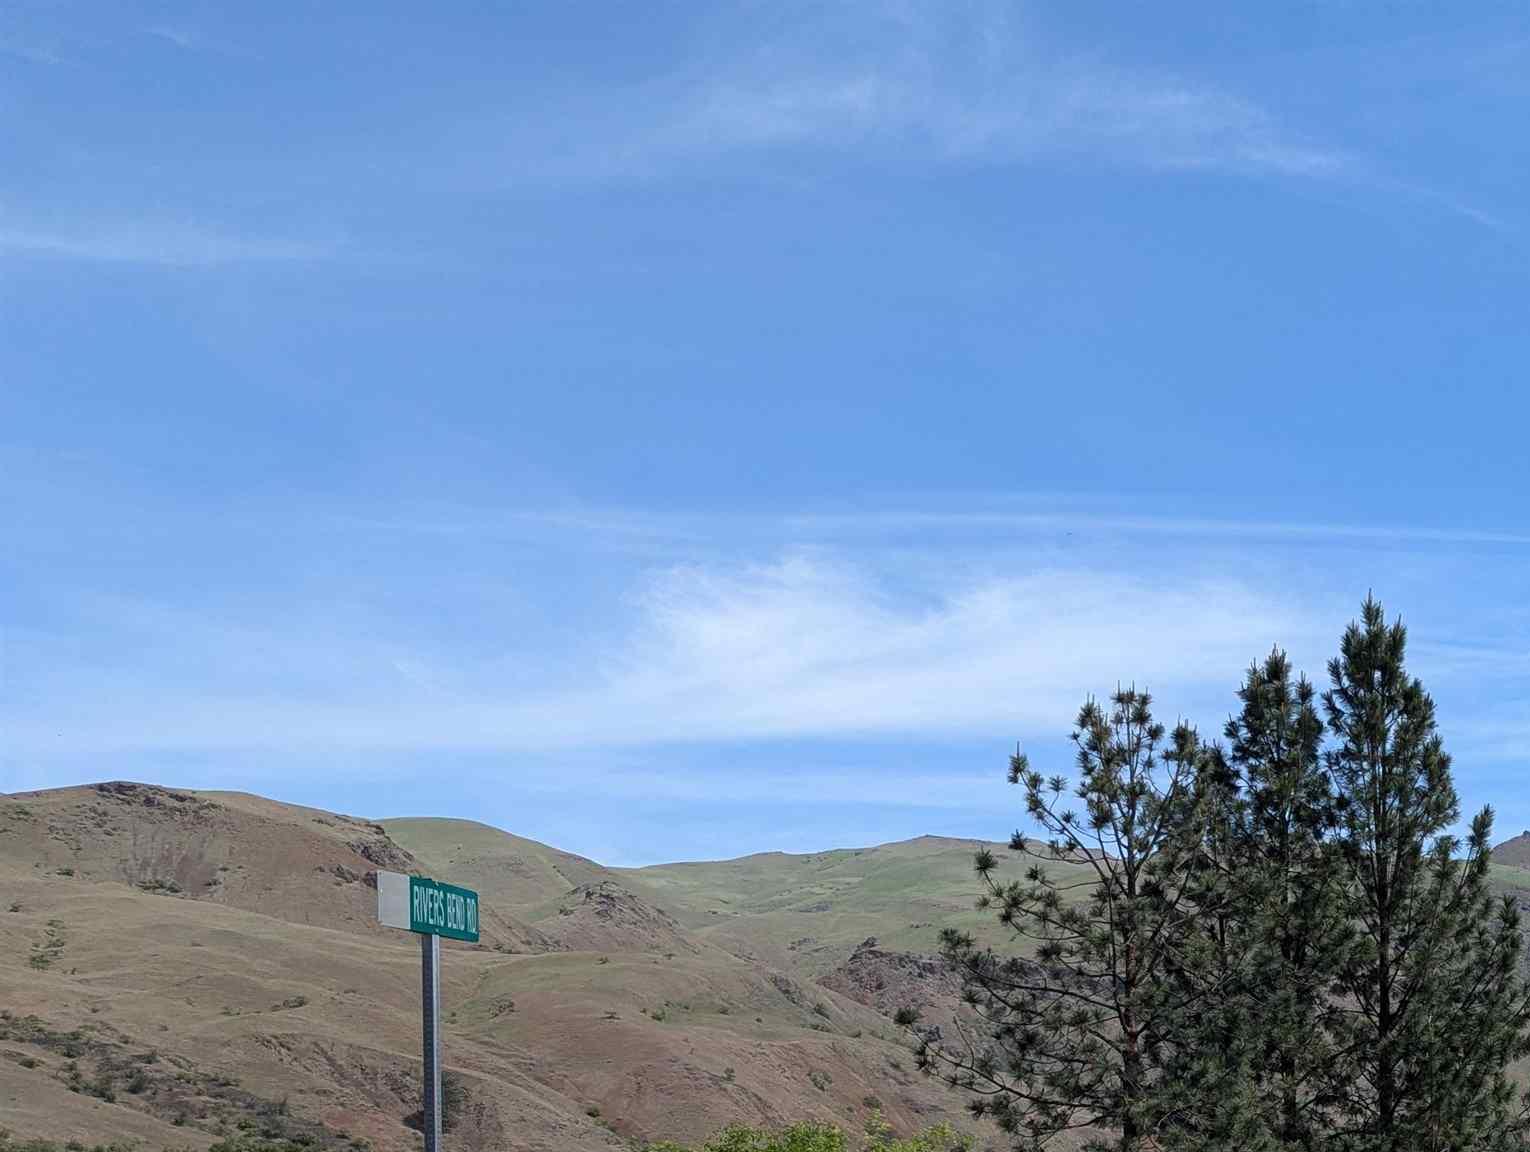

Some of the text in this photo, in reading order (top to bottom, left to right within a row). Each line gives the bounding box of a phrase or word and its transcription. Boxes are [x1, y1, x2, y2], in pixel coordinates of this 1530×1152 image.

[413, 885, 477, 934] RIVERS BEND RD
